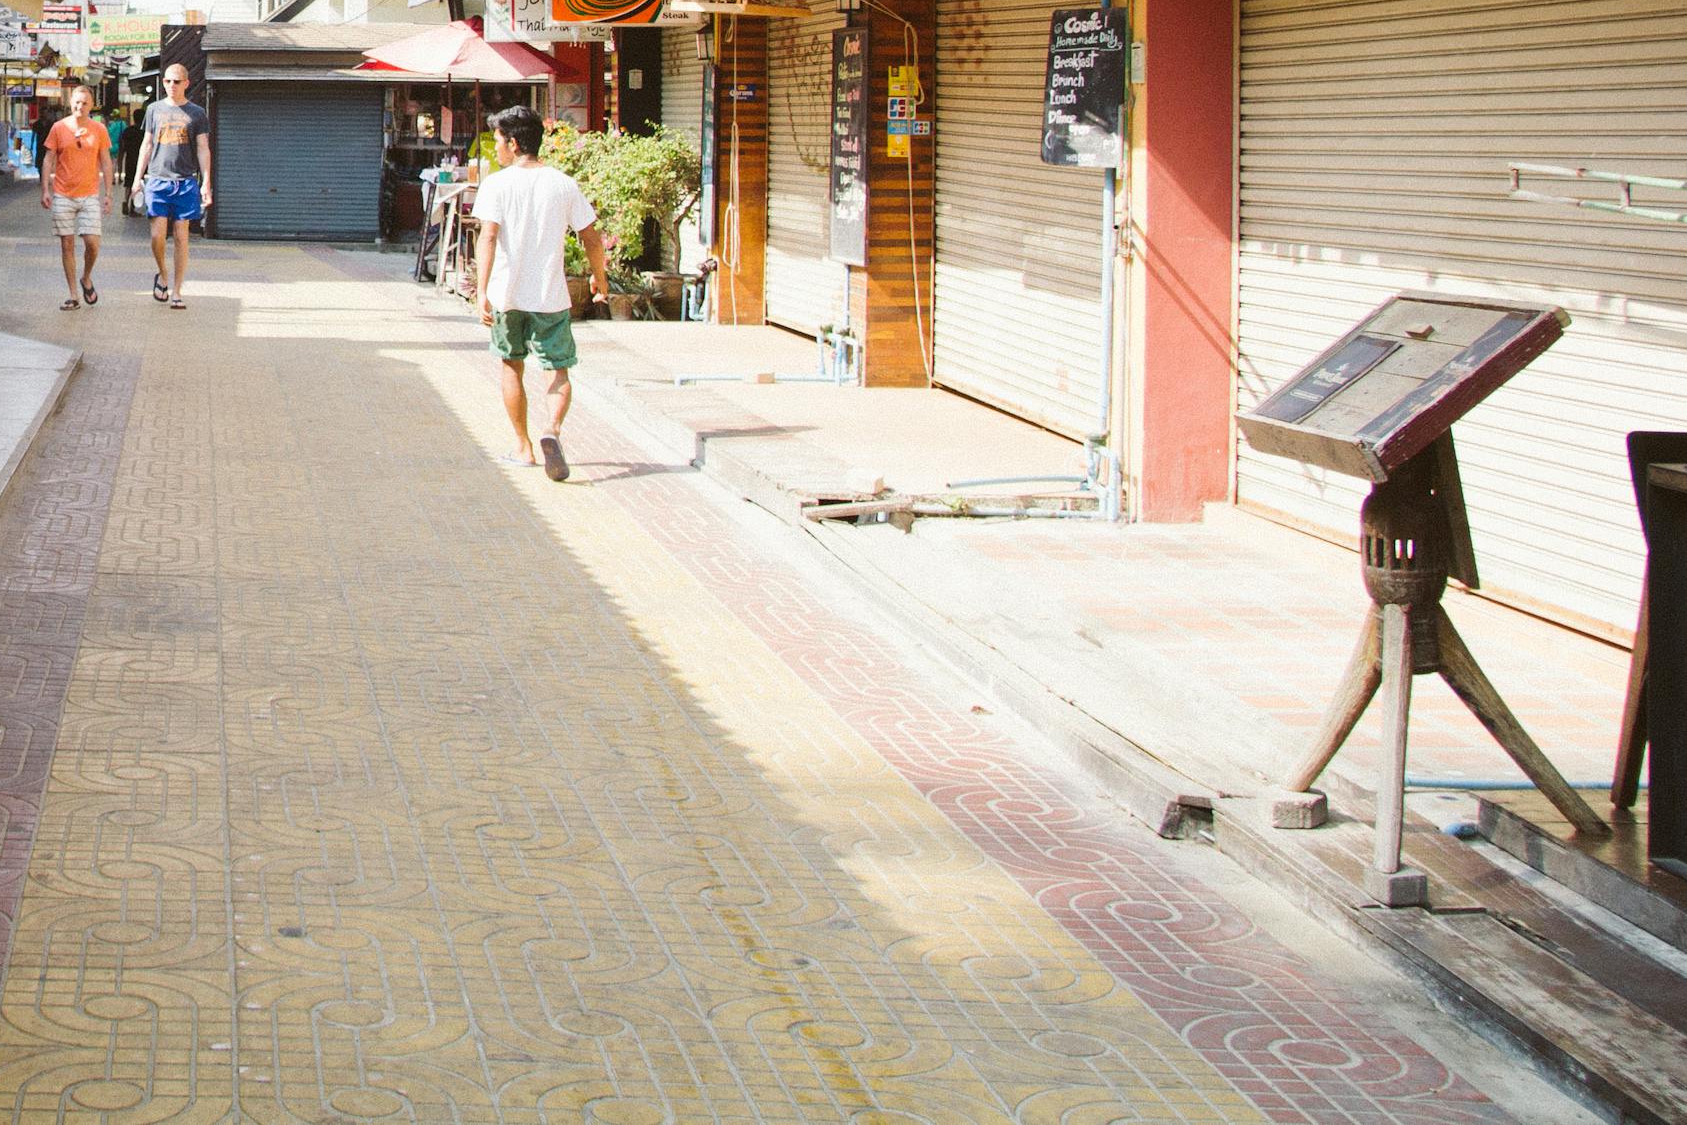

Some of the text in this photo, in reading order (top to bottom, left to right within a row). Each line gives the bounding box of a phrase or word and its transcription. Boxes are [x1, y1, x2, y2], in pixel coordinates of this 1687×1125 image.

[662, 11, 689, 19] Steak
[1063, 11, 1103, 34] Cosmic
[516, 17, 546, 32] Thai
[1053, 50, 1099, 72] Breakfast
[1051, 71, 1085, 88] Brunch
[1049, 89, 1077, 105] Lunch
